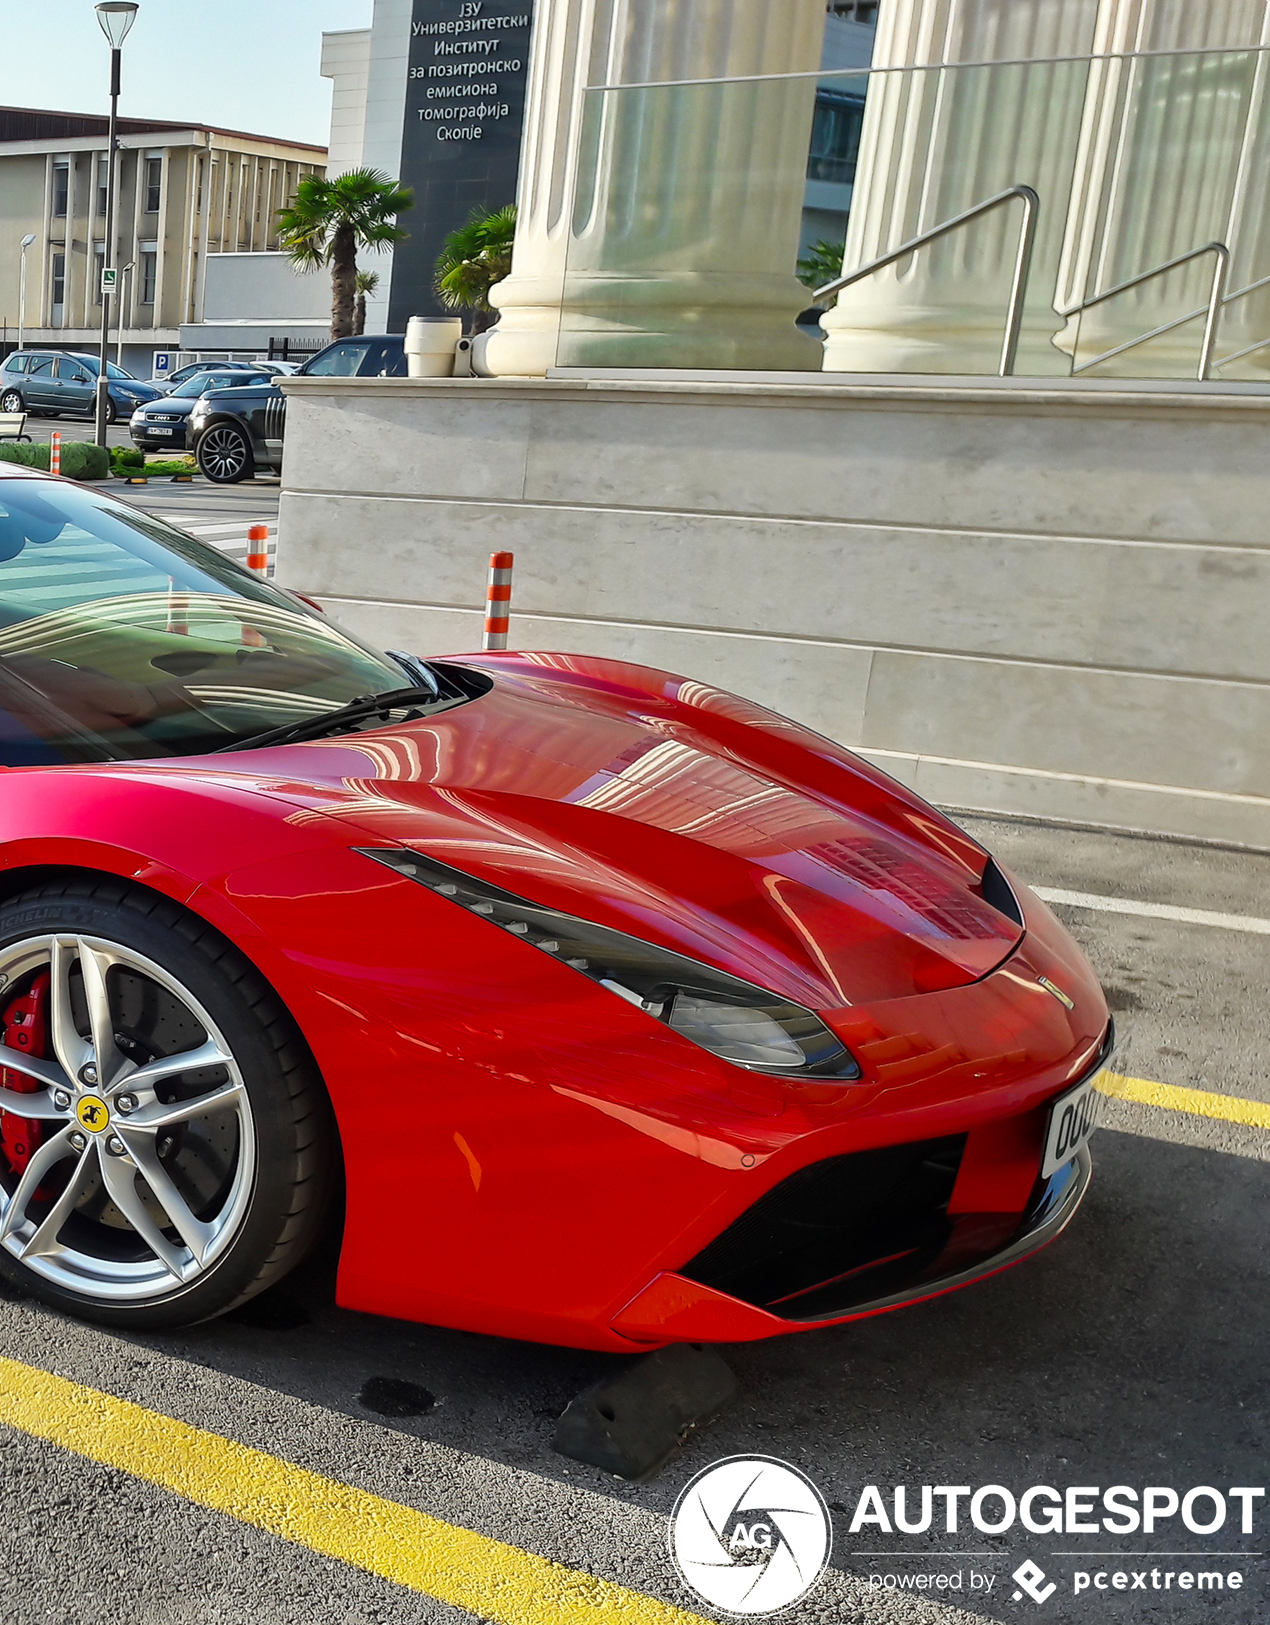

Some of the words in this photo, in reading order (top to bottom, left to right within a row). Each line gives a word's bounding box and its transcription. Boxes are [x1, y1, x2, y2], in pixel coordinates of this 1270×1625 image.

[412, 14, 528, 36] Универзитетски
[434, 39, 500, 56] Институт
[409, 67, 425, 79] за
[428, 59, 521, 78] позитронско
[426, 82, 498, 99] емисиона
[418, 102, 509, 121] томографија
[436, 124, 482, 141] Скопје
[158, 355, 166, 368] P
